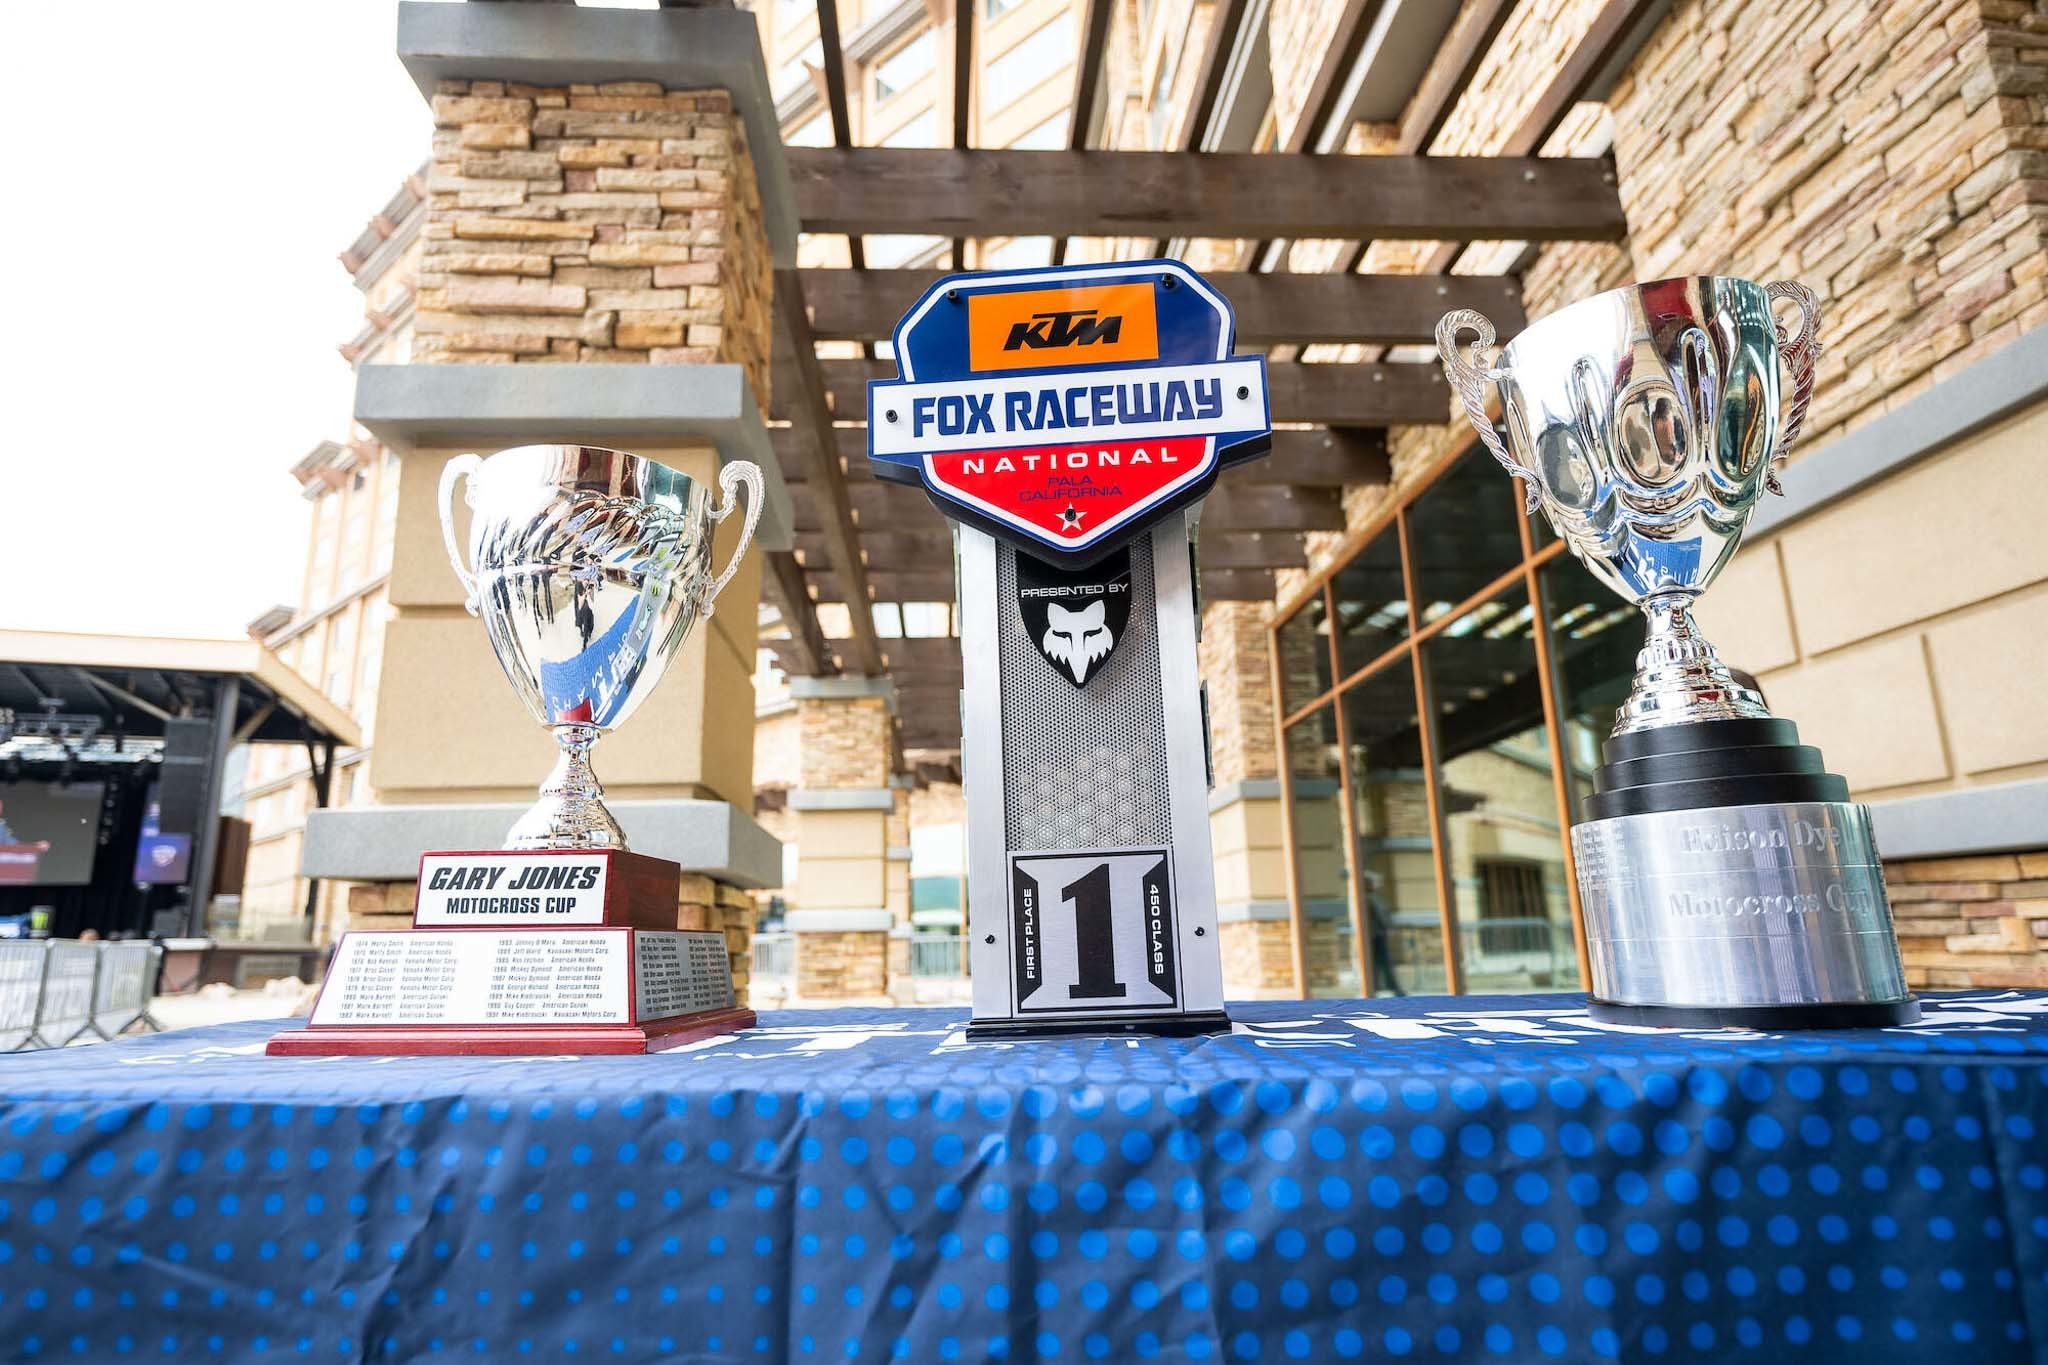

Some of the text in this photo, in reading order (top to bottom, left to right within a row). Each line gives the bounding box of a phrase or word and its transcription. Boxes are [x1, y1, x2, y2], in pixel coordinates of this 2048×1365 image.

[1003, 310, 1122, 350] KTM
[913, 378, 1225, 438] FOX RACEWAY
[962, 447, 1178, 475] NATIONAL
[1019, 486, 1122, 502] CALIFORNIA
[1047, 476, 1093, 487] PALA
[1021, 583, 1128, 598] PRESENTED BY
[1681, 820, 1840, 851] Edison Dye
[428, 866, 600, 890] GARY JONES
[446, 897, 576, 914] MOTOCROSS CUP
[1667, 892, 1820, 916] Motocross
[1023, 888, 1036, 979] FIRST PLACE
[1061, 863, 1126, 999] 1
[1149, 884, 1164, 974] 450 CLASS
